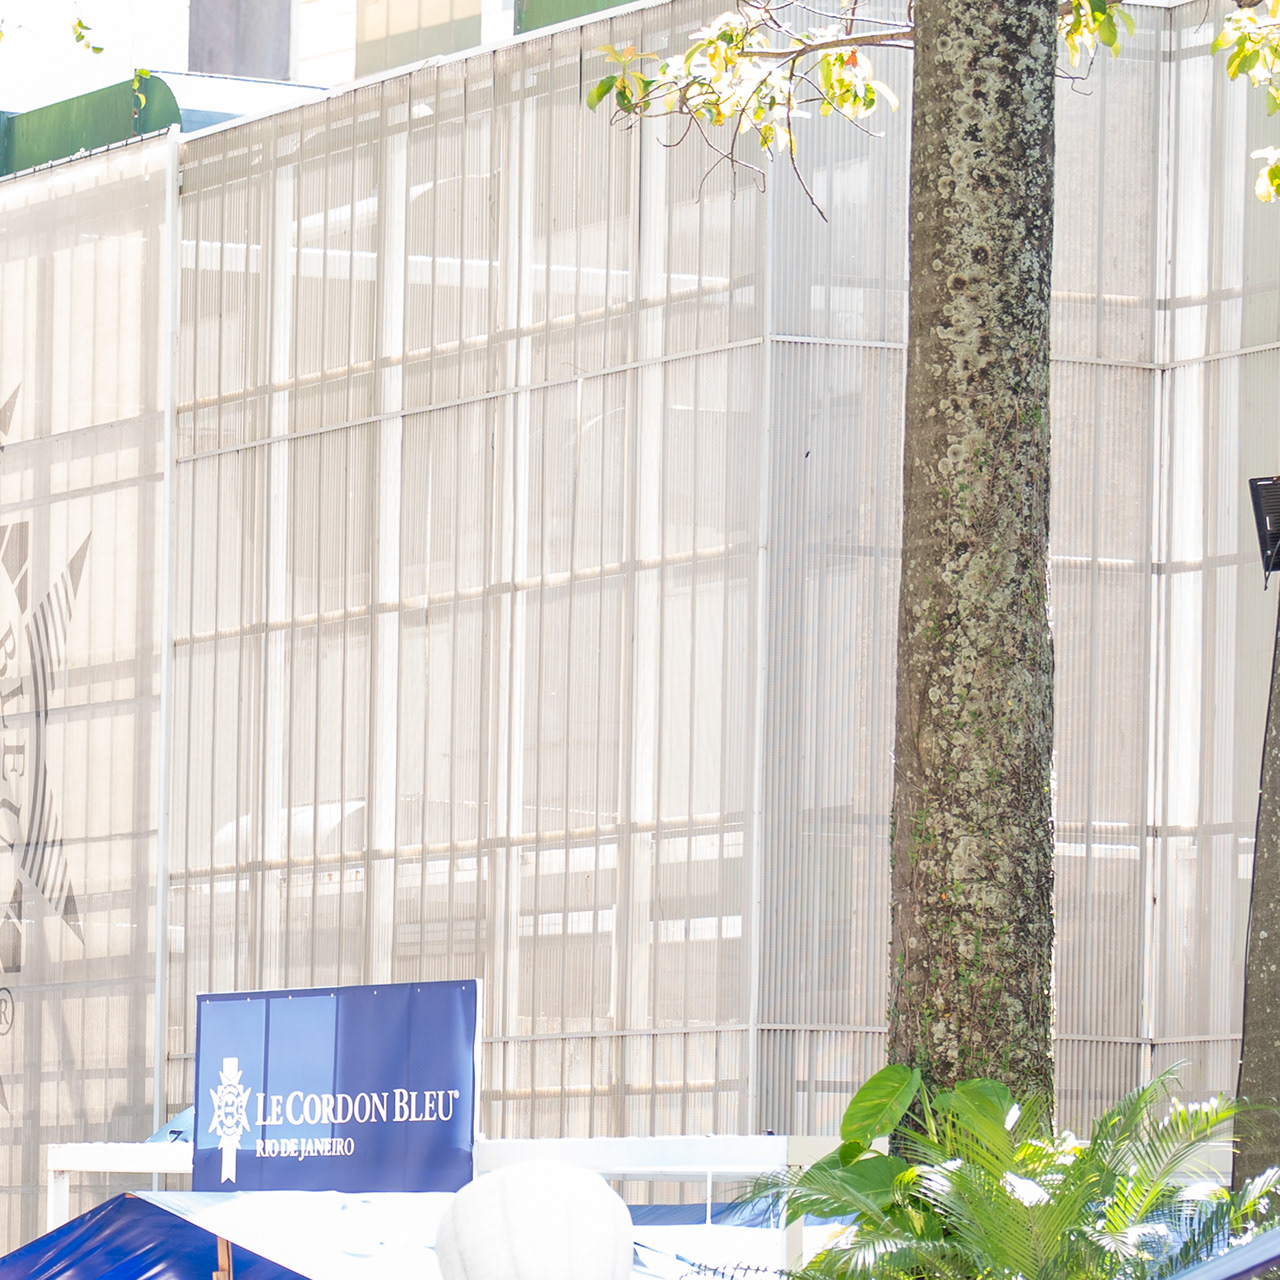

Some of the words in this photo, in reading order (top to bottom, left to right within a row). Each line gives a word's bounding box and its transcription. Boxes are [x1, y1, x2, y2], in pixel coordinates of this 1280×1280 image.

[255, 1092, 283, 1126] LE
[285, 1091, 389, 1125] CORDON
[255, 1138, 279, 1157] RIO
[280, 1138, 299, 1157] DE
[298, 1137, 355, 1161] JANEIRO
